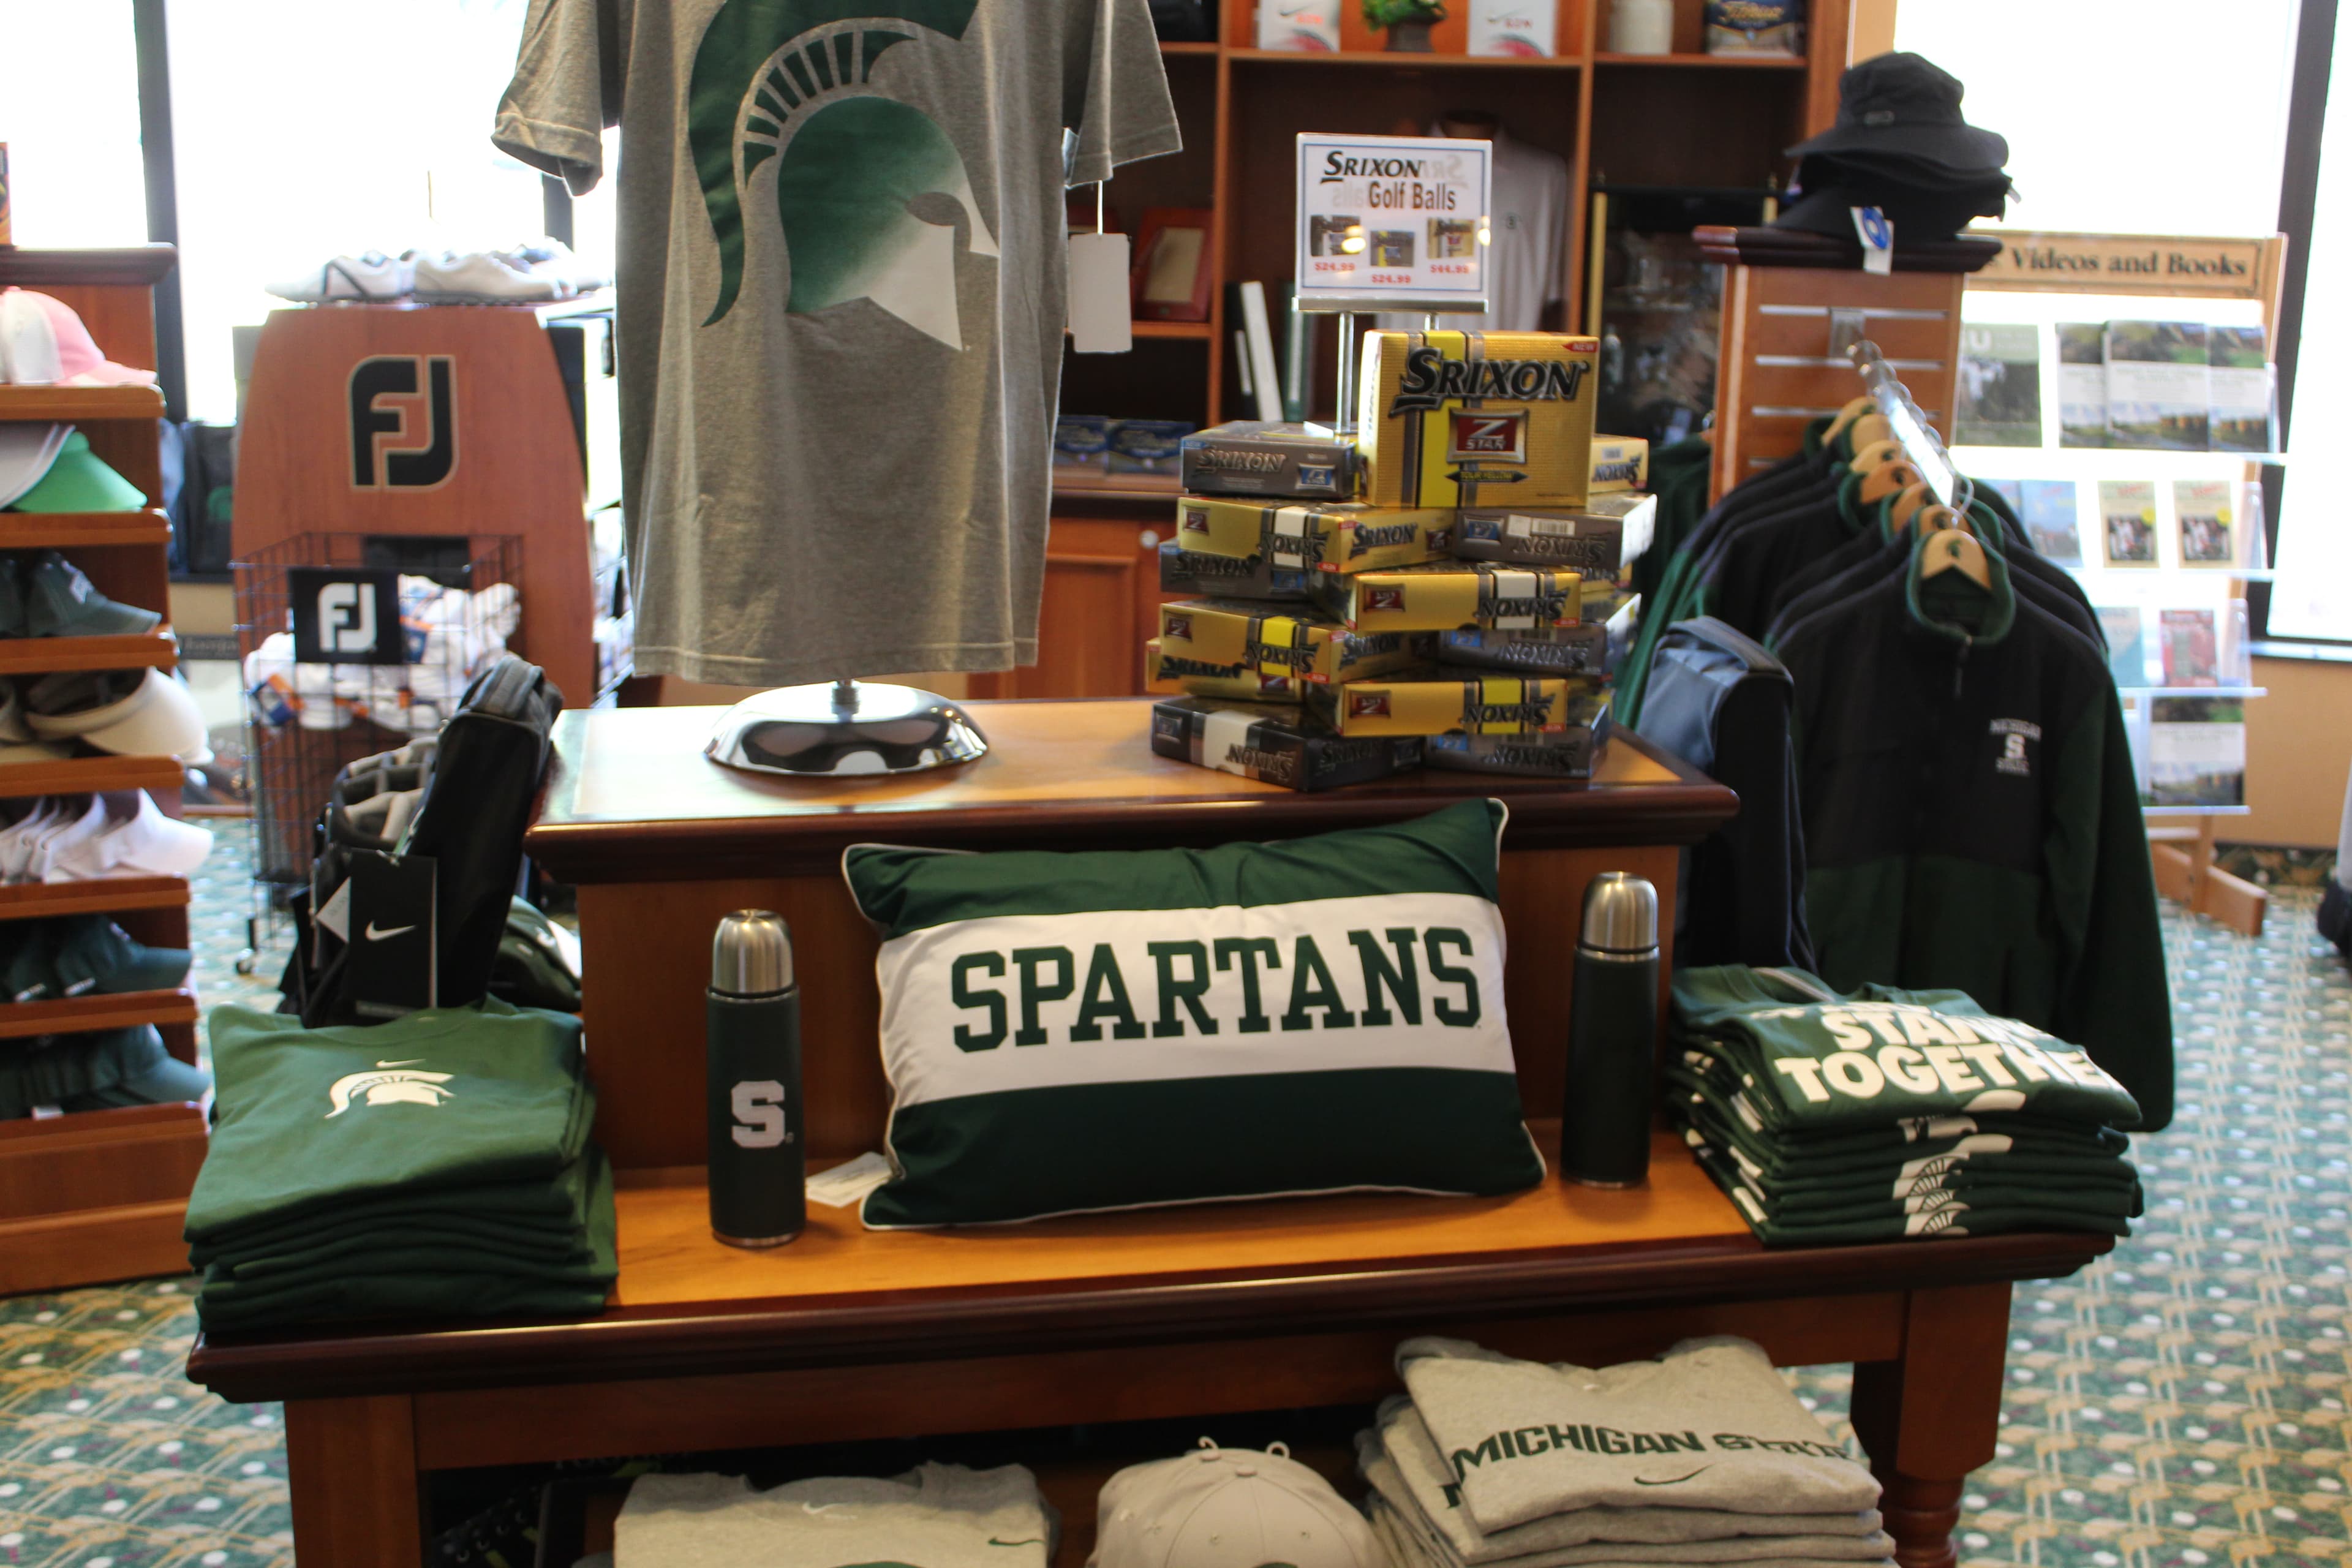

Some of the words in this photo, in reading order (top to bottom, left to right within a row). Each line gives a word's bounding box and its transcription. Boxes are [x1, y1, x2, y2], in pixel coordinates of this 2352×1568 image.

[1321, 151, 1423, 181] SRIXON
[1369, 181, 1406, 208] Golf
[1411, 184, 1456, 210] Balls
[2011, 247, 2100, 272] Videos
[2109, 250, 2158, 273] and
[2168, 252, 2247, 276] Books
[1393, 347, 1589, 409] SRIXON
[348, 355, 458, 489] FJ
[1466, 439, 1506, 450] STAR
[1468, 419, 1509, 439] Z
[1351, 524, 1418, 556] SRIXON
[317, 582, 377, 654] FJ
[951, 927, 1481, 1054] SPARTANS
[731, 1080, 785, 1148] S
[1452, 1424, 1706, 1485] MICHIGAN
